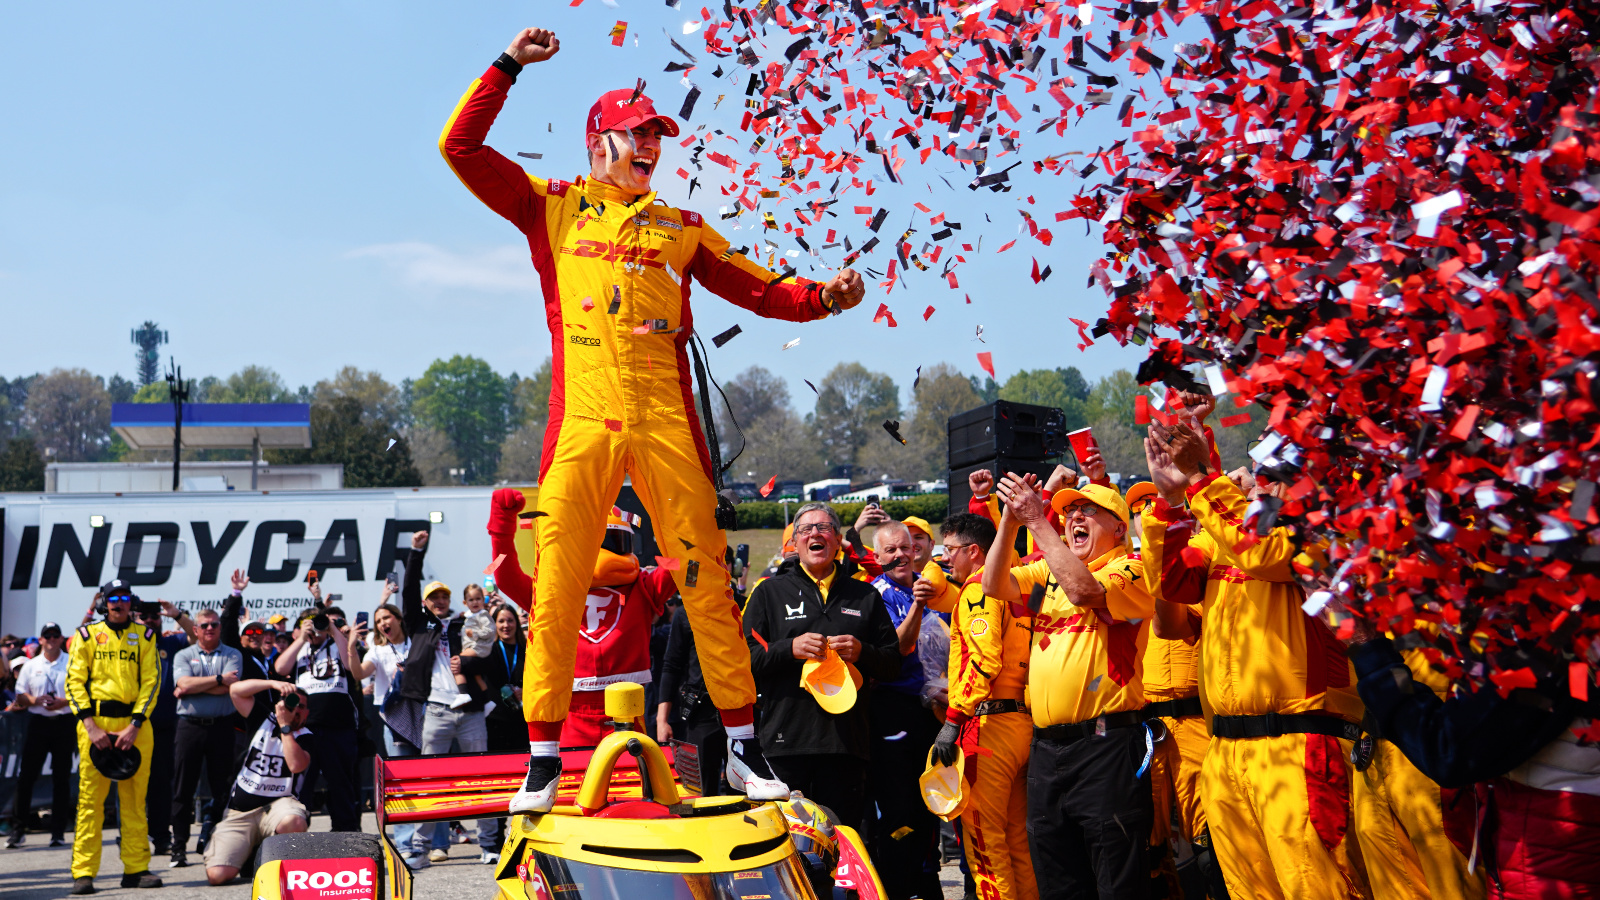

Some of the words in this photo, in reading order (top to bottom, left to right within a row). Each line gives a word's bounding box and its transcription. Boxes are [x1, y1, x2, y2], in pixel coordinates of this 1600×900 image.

[571, 239, 666, 270] DHL
[570, 335, 601, 346] sparco
[10, 518, 432, 590] INDYCAR
[189, 600, 224, 611] TIMIN
[245, 599, 263, 609] ND
[266, 597, 315, 609] SCORIN
[1033, 613, 1088, 635] DHL
[286, 867, 373, 891] Root
[319, 887, 372, 897] Insurance
